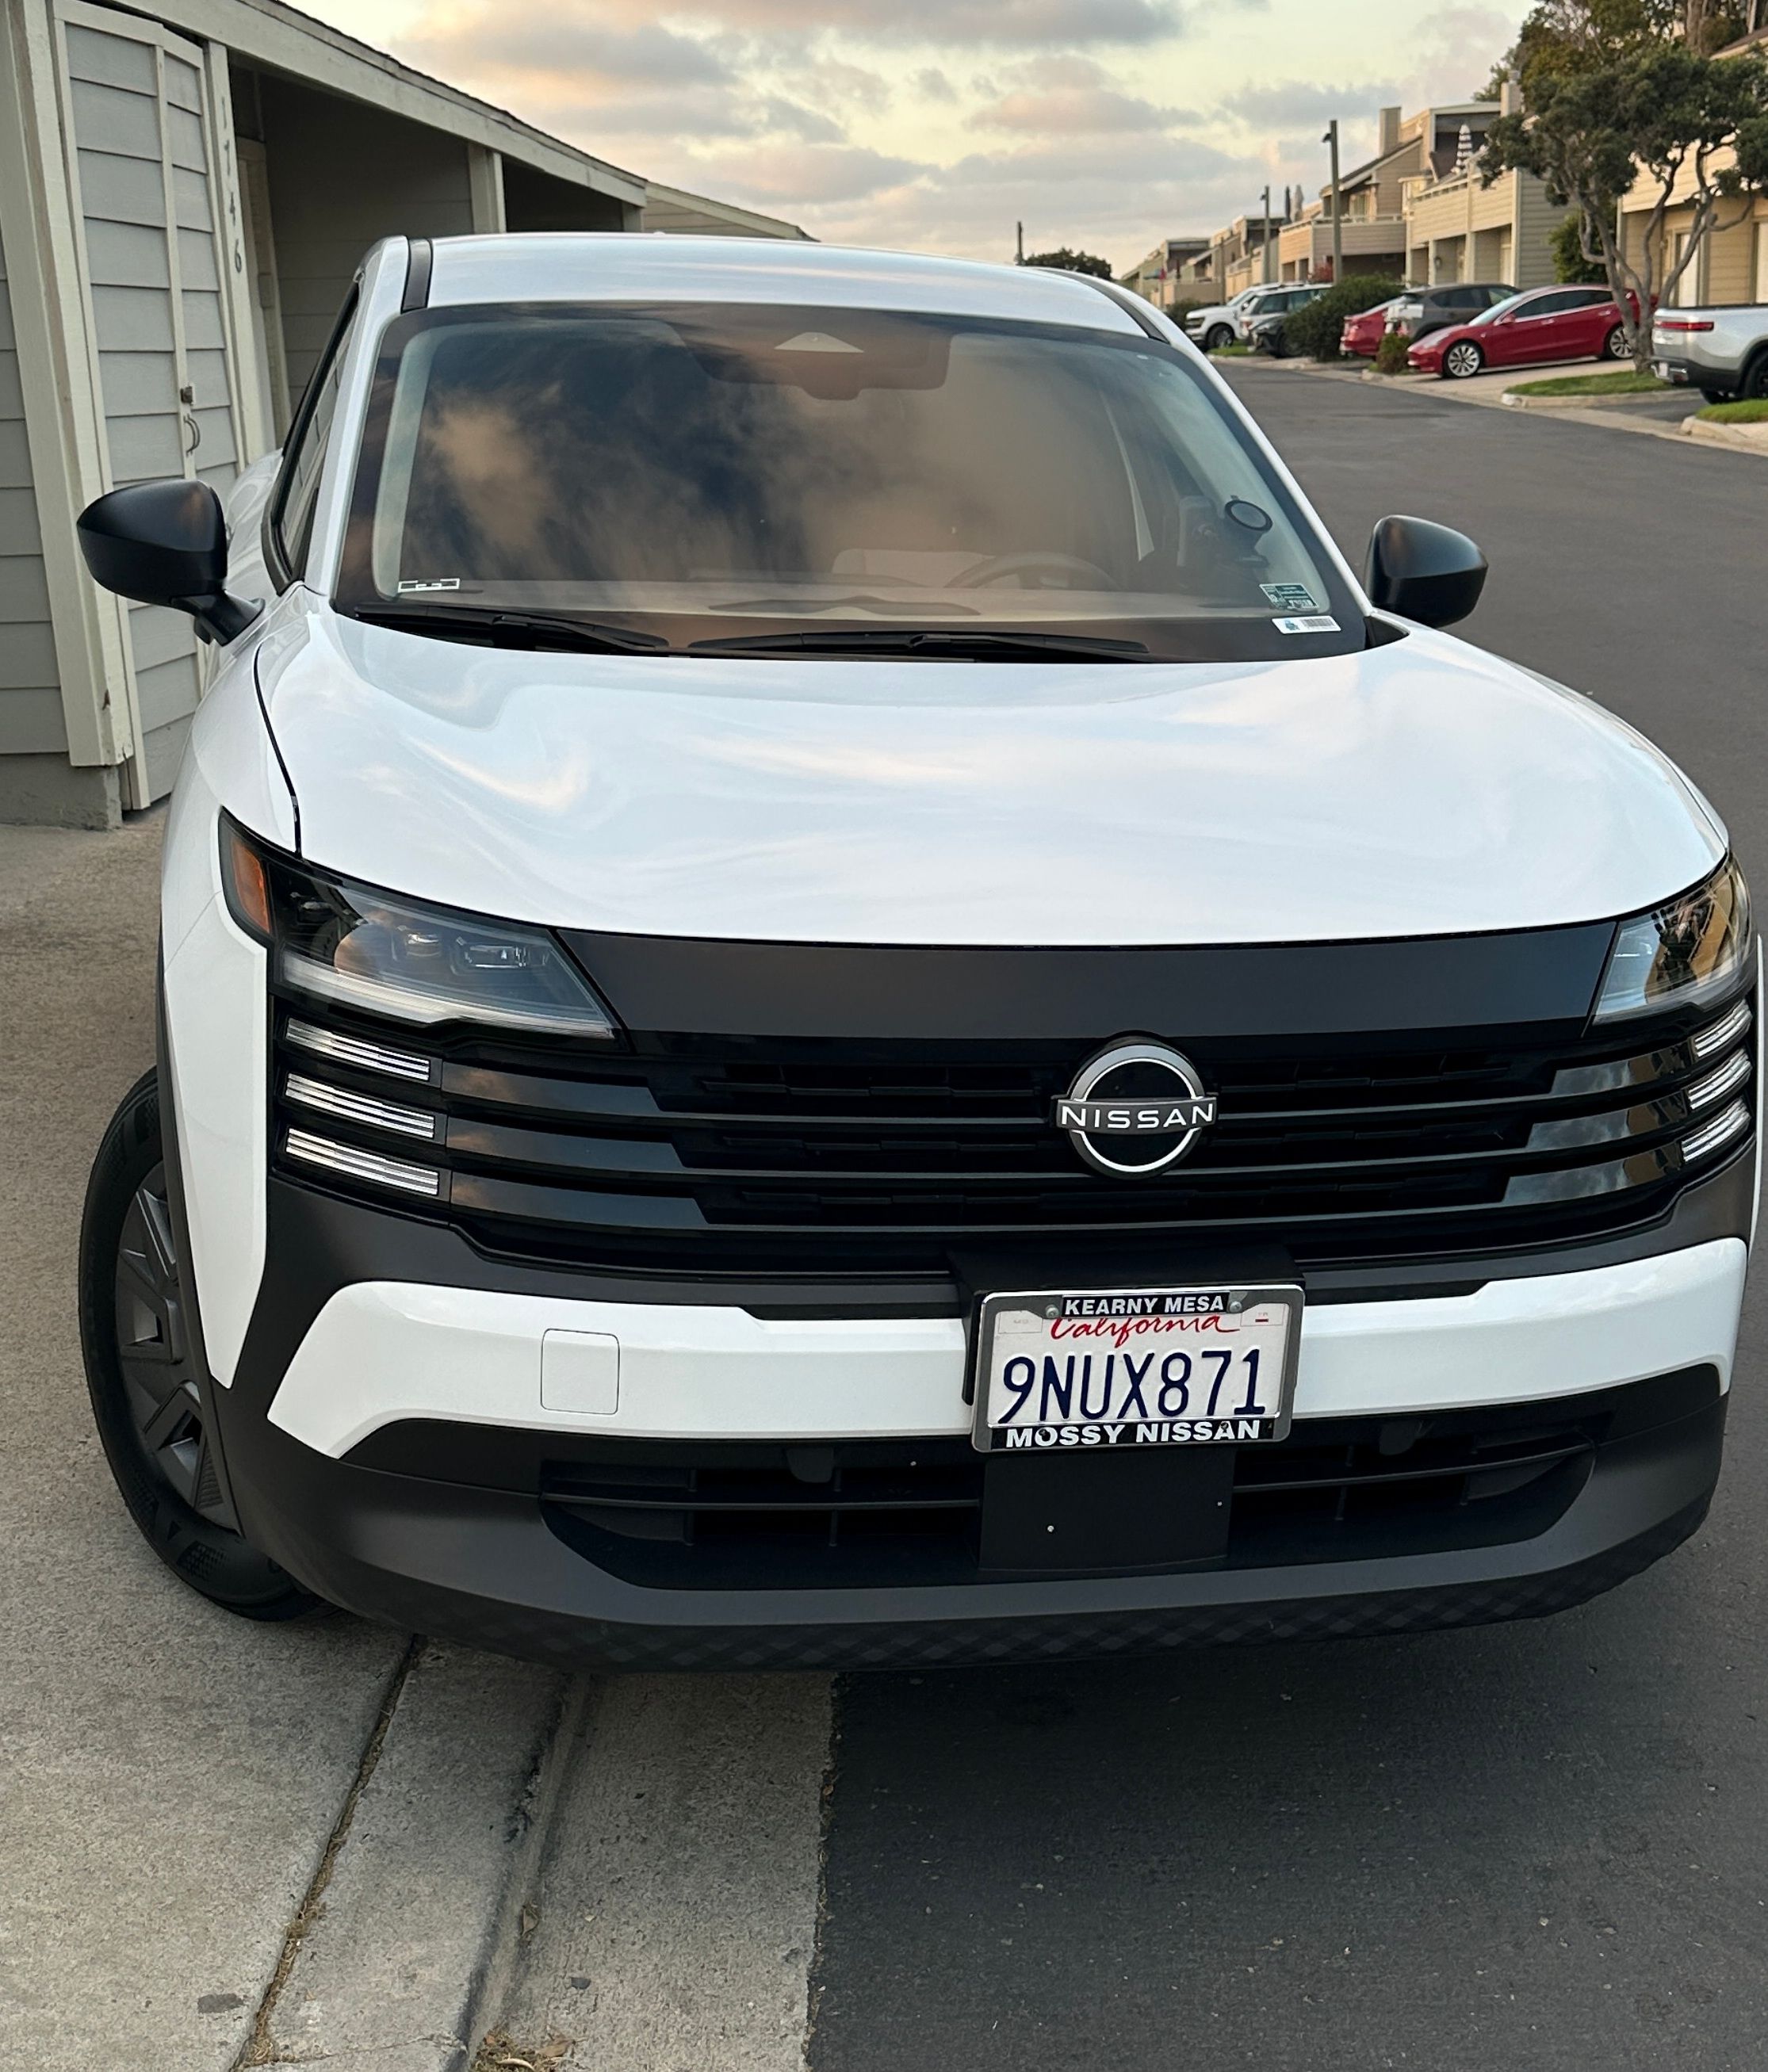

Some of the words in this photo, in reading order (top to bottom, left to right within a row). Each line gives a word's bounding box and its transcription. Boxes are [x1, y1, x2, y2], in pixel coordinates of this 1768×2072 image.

[1061, 1103, 1214, 1129] NISSAN
[1065, 1298, 1158, 1316] KEARNY
[1164, 1295, 1223, 1313] MESA
[1050, 1313, 1240, 1348] California
[997, 1348, 1266, 1424] 9NUX871
[1005, 1424, 1127, 1448] MOSSY
[1135, 1420, 1261, 1443] NISSAN
